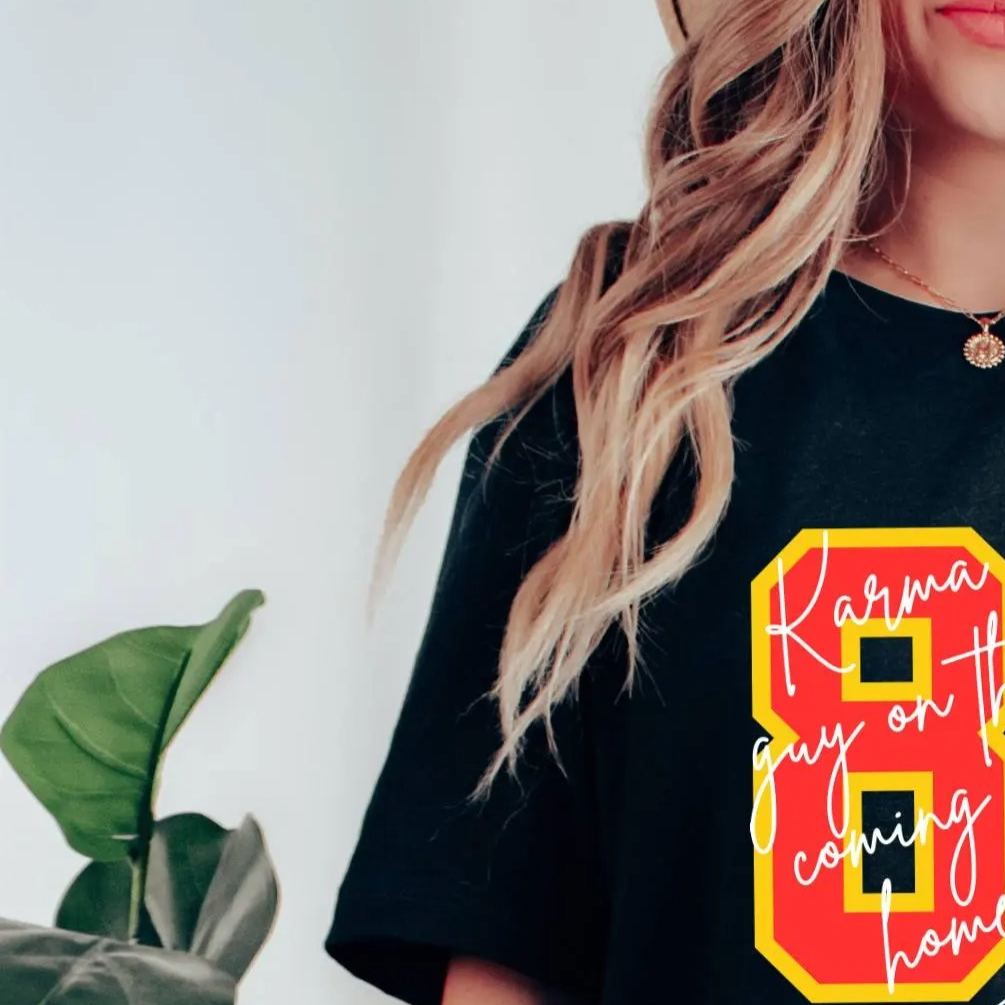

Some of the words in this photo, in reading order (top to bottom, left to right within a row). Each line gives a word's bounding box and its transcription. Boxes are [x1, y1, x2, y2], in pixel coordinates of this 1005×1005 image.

[765, 530, 990, 697] Karma
[749, 720, 867, 855] guy
[887, 693, 956, 733] on
[793, 787, 993, 907] coming
